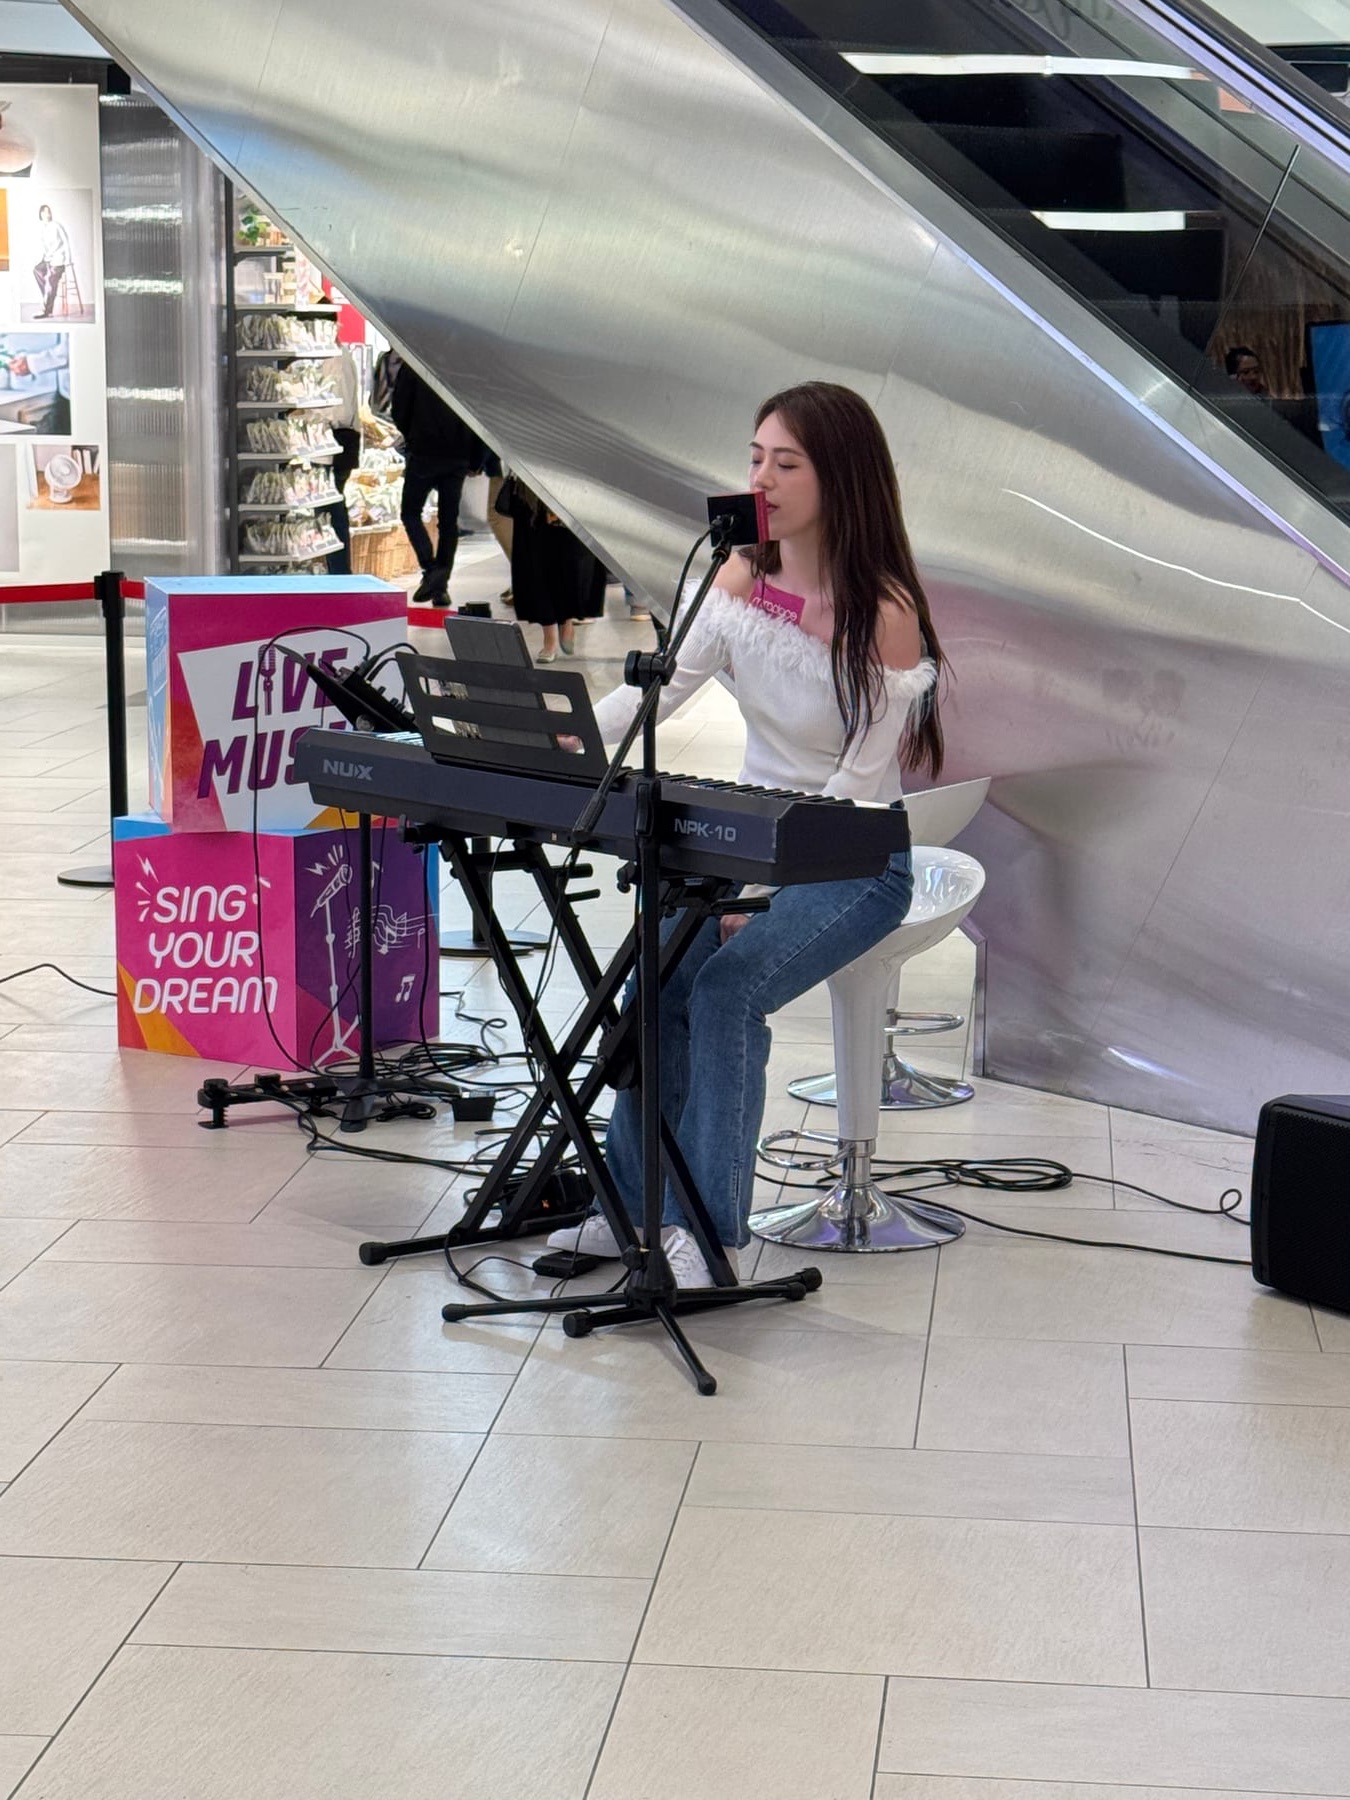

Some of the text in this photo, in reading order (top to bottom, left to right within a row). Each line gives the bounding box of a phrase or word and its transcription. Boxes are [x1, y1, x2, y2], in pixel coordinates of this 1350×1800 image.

[322, 759, 374, 780] NUX
[674, 818, 737, 842] NPK-10
[153, 885, 247, 923] SING
[148, 931, 260, 968] YOUR
[132, 976, 279, 1015] DREAM
